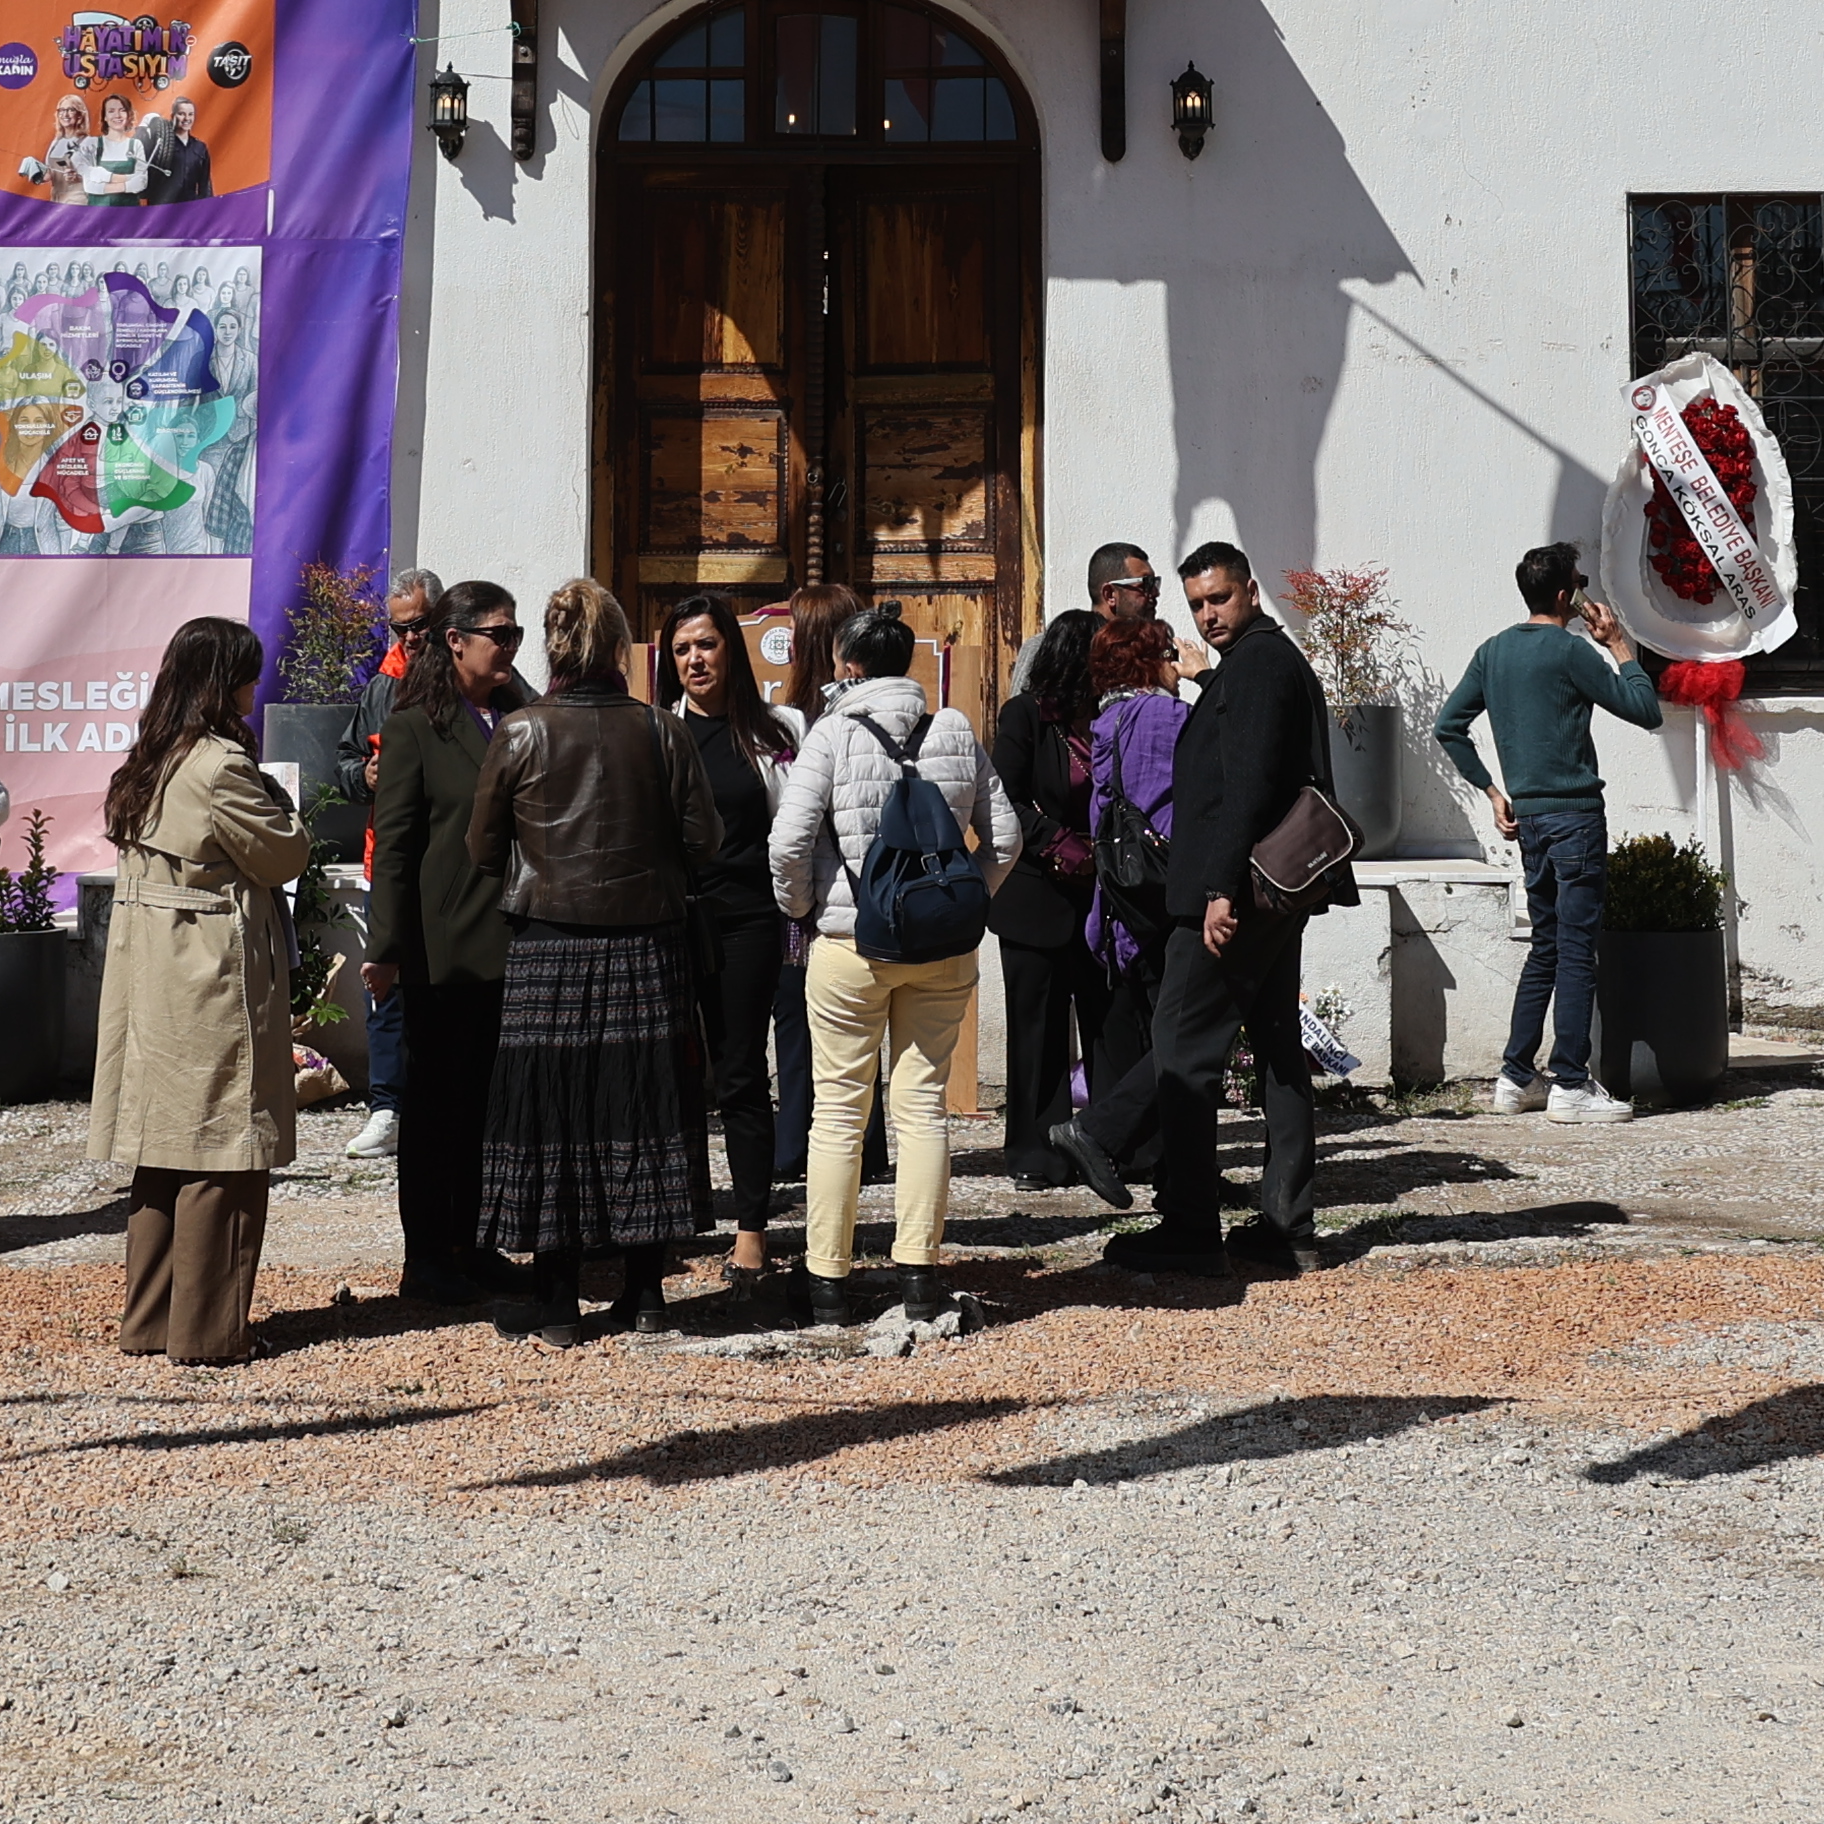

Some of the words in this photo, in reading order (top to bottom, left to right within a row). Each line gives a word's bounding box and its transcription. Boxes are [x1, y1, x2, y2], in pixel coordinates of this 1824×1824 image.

[63, 26, 189, 52] HAYATIMIN
[63, 54, 187, 79] USTASIYIM
[213, 54, 252, 69] TAŞIT
[19, 372, 53, 381] ULAŞIM
[1635, 415, 1674, 483] GONCA
[1672, 485, 1723, 570] KÖKSAL
[1723, 572, 1757, 620] ARAS
[1652, 406, 1700, 474] MENTEŞE
[1690, 475, 1746, 552] BELEDİYE
[1734, 548, 1778, 609] BAŞKANI
[4, 713, 71, 753] İLK
